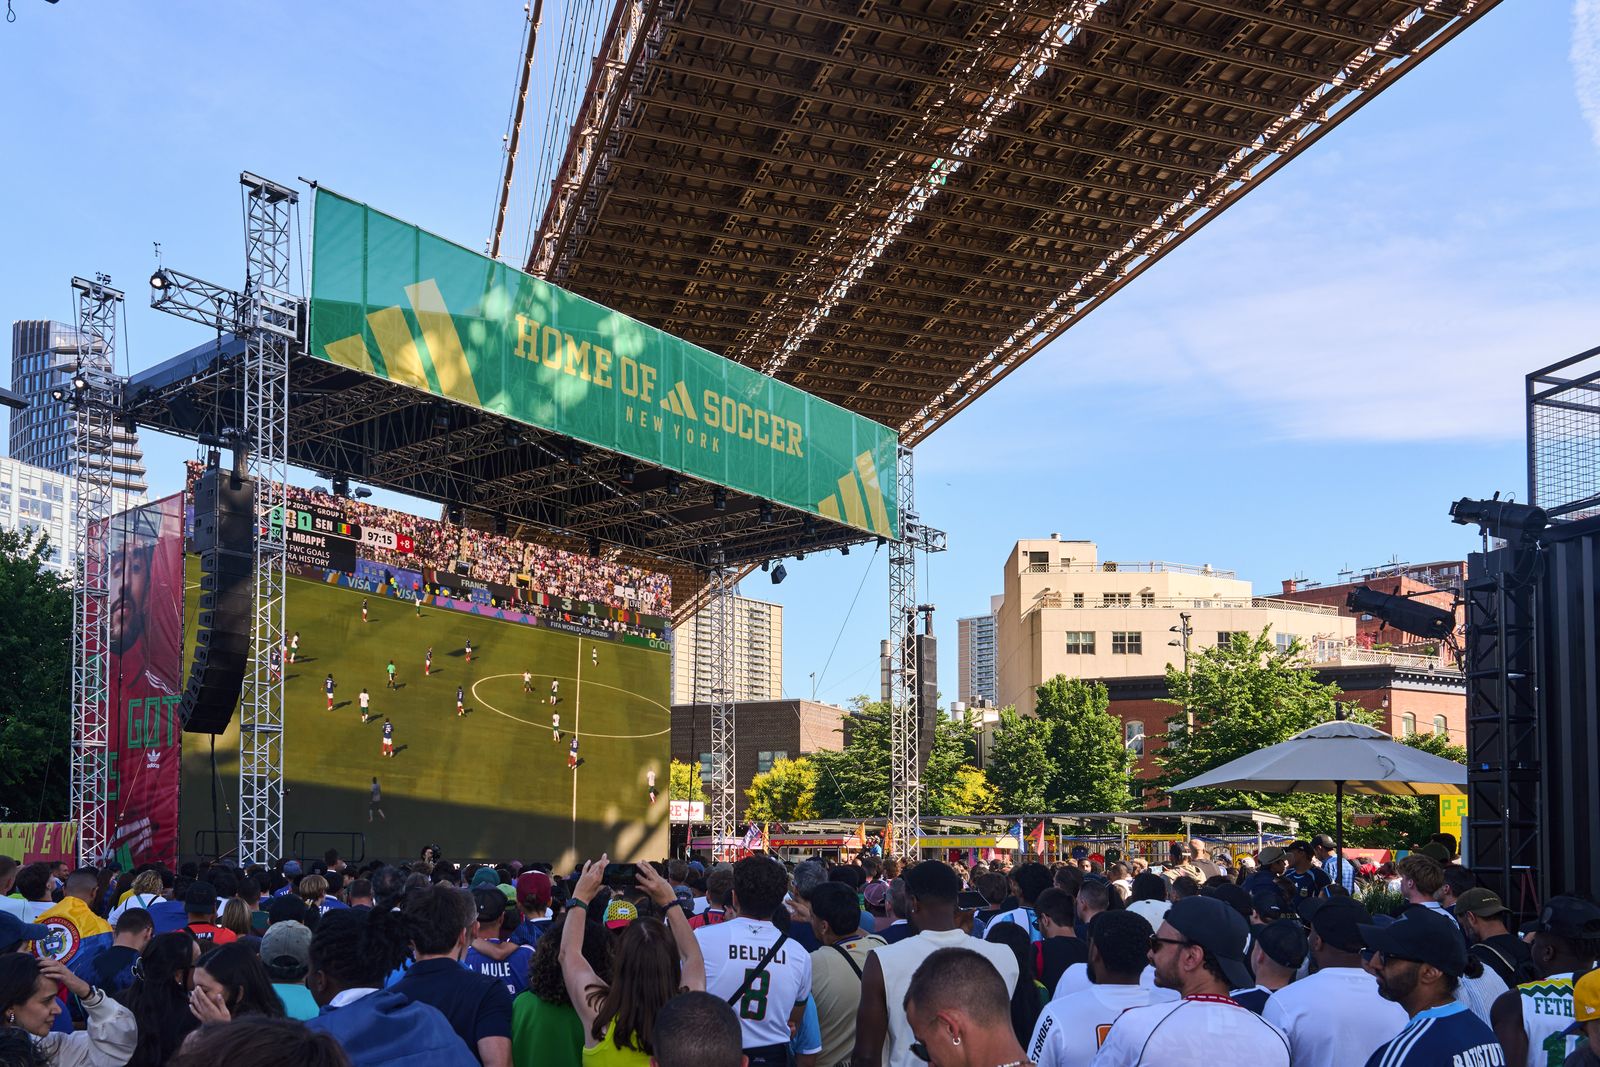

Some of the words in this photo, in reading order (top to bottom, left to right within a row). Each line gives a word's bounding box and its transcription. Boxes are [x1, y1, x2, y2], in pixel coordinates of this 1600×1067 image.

[514, 313, 613, 389] HOME
[620, 356, 657, 403] OF
[703, 389, 804, 458] SOCCER
[626, 405, 663, 433] NEW
[674, 424, 720, 453] YORK
[317, 508, 339, 518] GROUP
[302, 515, 308, 527] 1
[315, 518, 333, 532] SEN
[292, 532, 326, 548] MBAPPÉ
[367, 531, 393, 545] 97:15
[399, 538, 411, 549] +8
[289, 544, 305, 554] FWC
[306, 547, 330, 559] GOALS
[298, 554, 330, 567] HISTORY
[347, 576, 371, 591] VISA
[461, 579, 488, 591] FRANCE
[629, 599, 641, 609] LIVE
[638, 591, 656, 604] FOX
[561, 598, 572, 611] 3
[587, 603, 597, 616] 1
[550, 621, 561, 630] FIFA
[562, 623, 580, 633] WORLD
[580, 626, 591, 634] CUP
[127, 695, 183, 749] GOT
[25, 823, 77, 855] NEW
[481, 962, 511, 977] MULE
[739, 968, 771, 1021] 8
